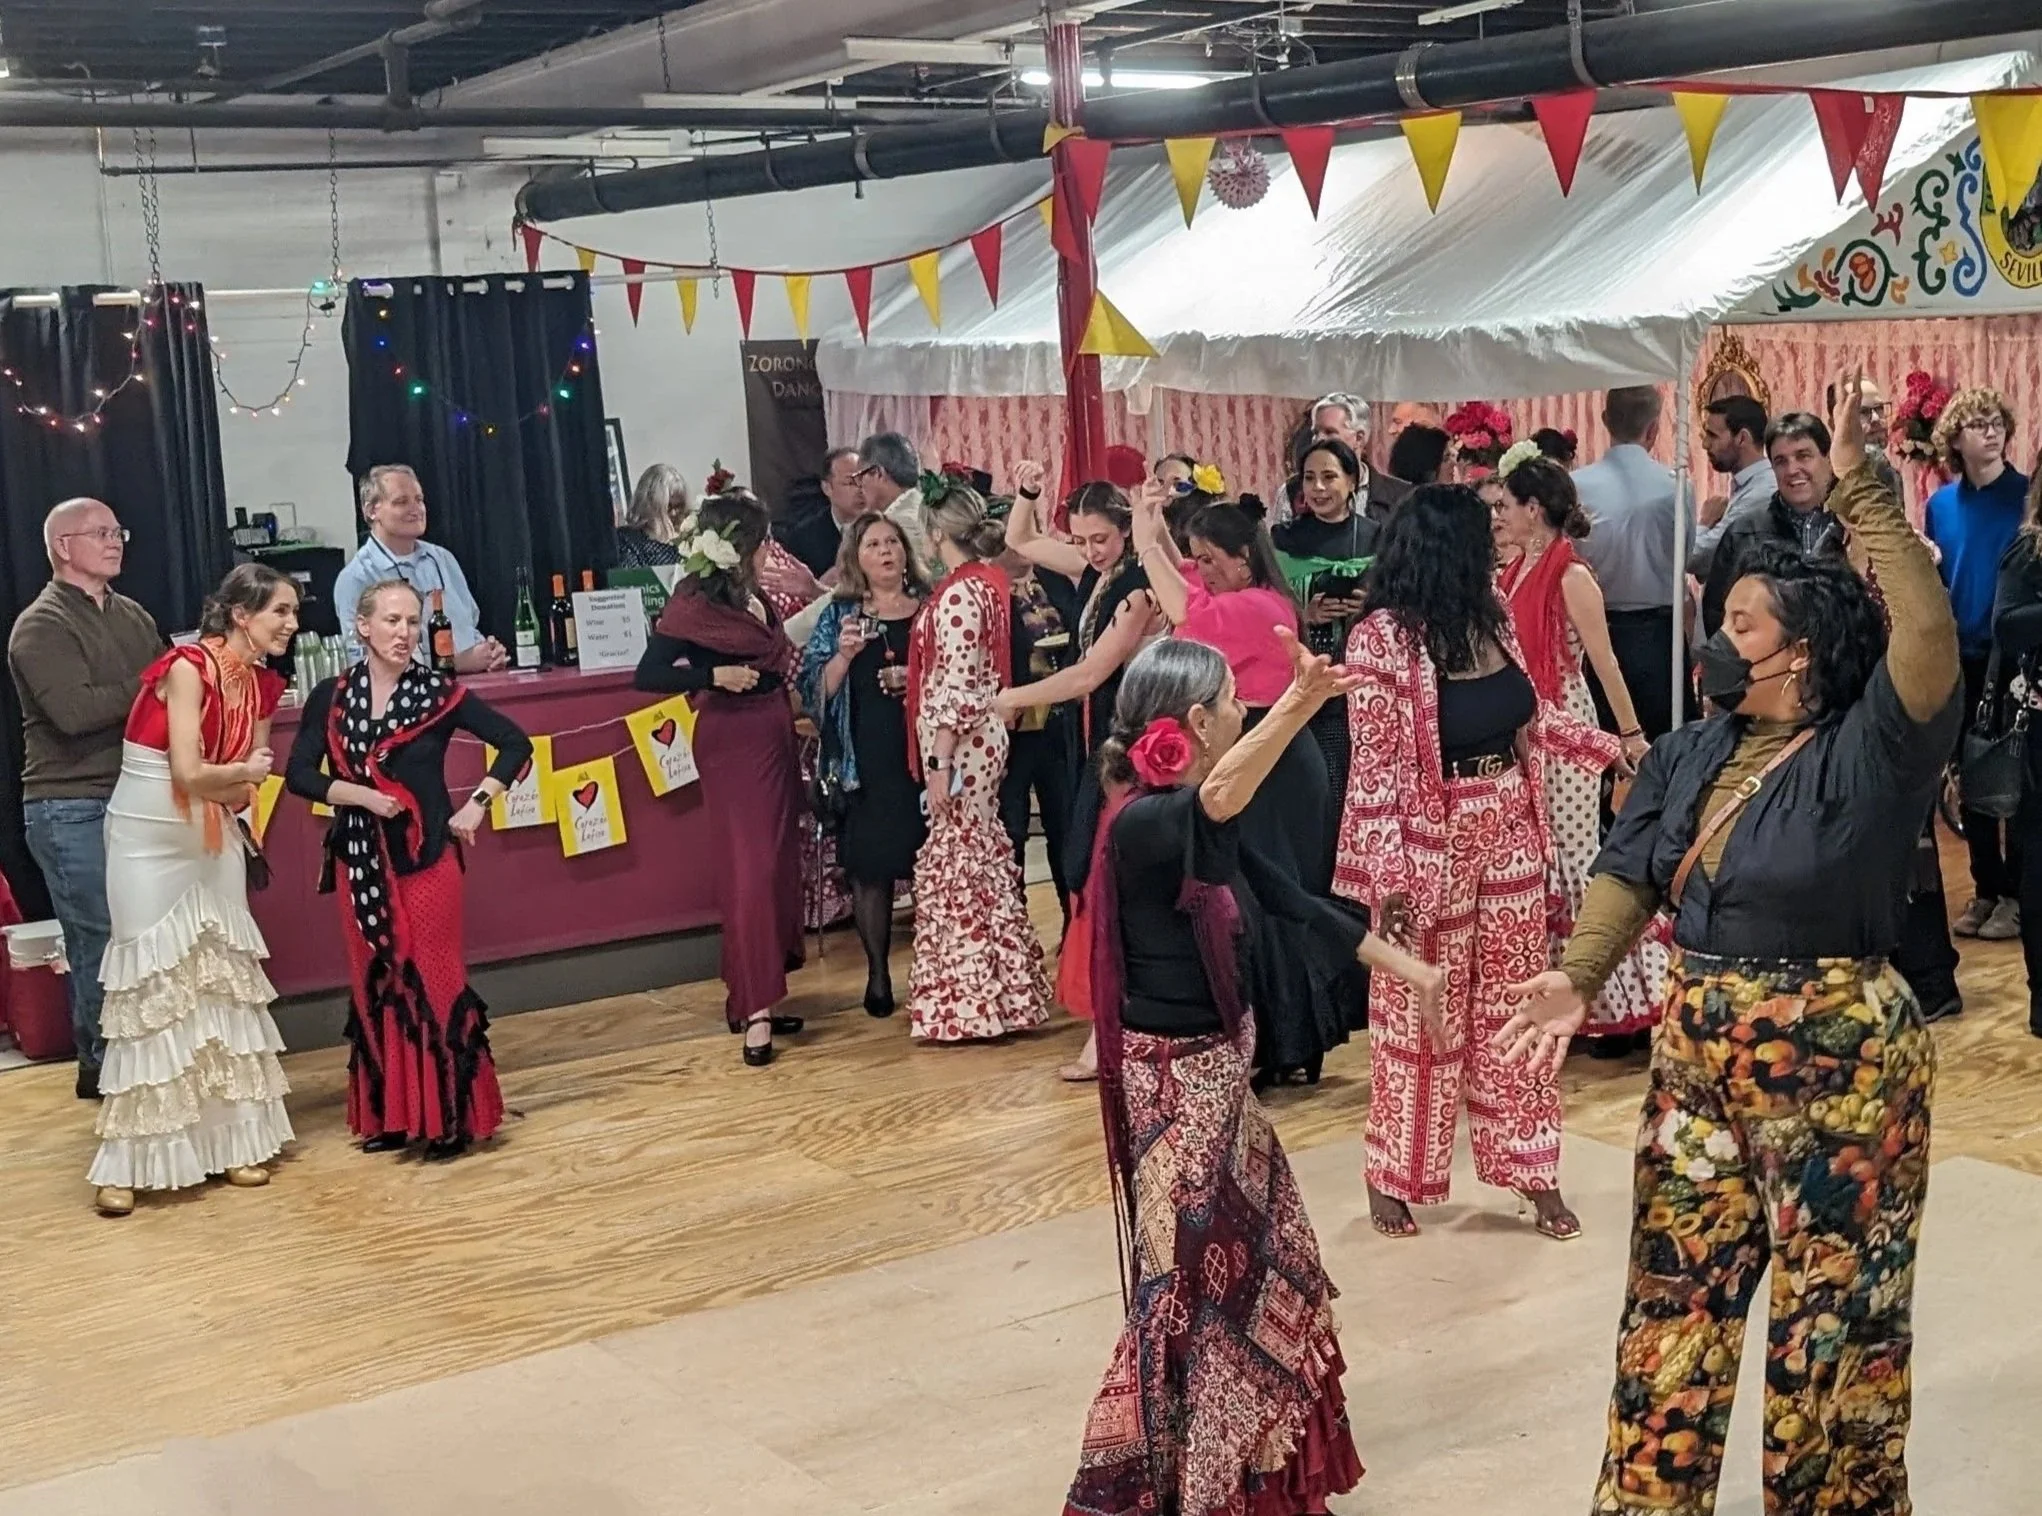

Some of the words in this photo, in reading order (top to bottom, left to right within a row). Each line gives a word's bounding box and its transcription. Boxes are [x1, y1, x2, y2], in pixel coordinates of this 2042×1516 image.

[588, 593, 626, 603] Suggested
[586, 619, 605, 627] Wine
[588, 633, 609, 641] Water
